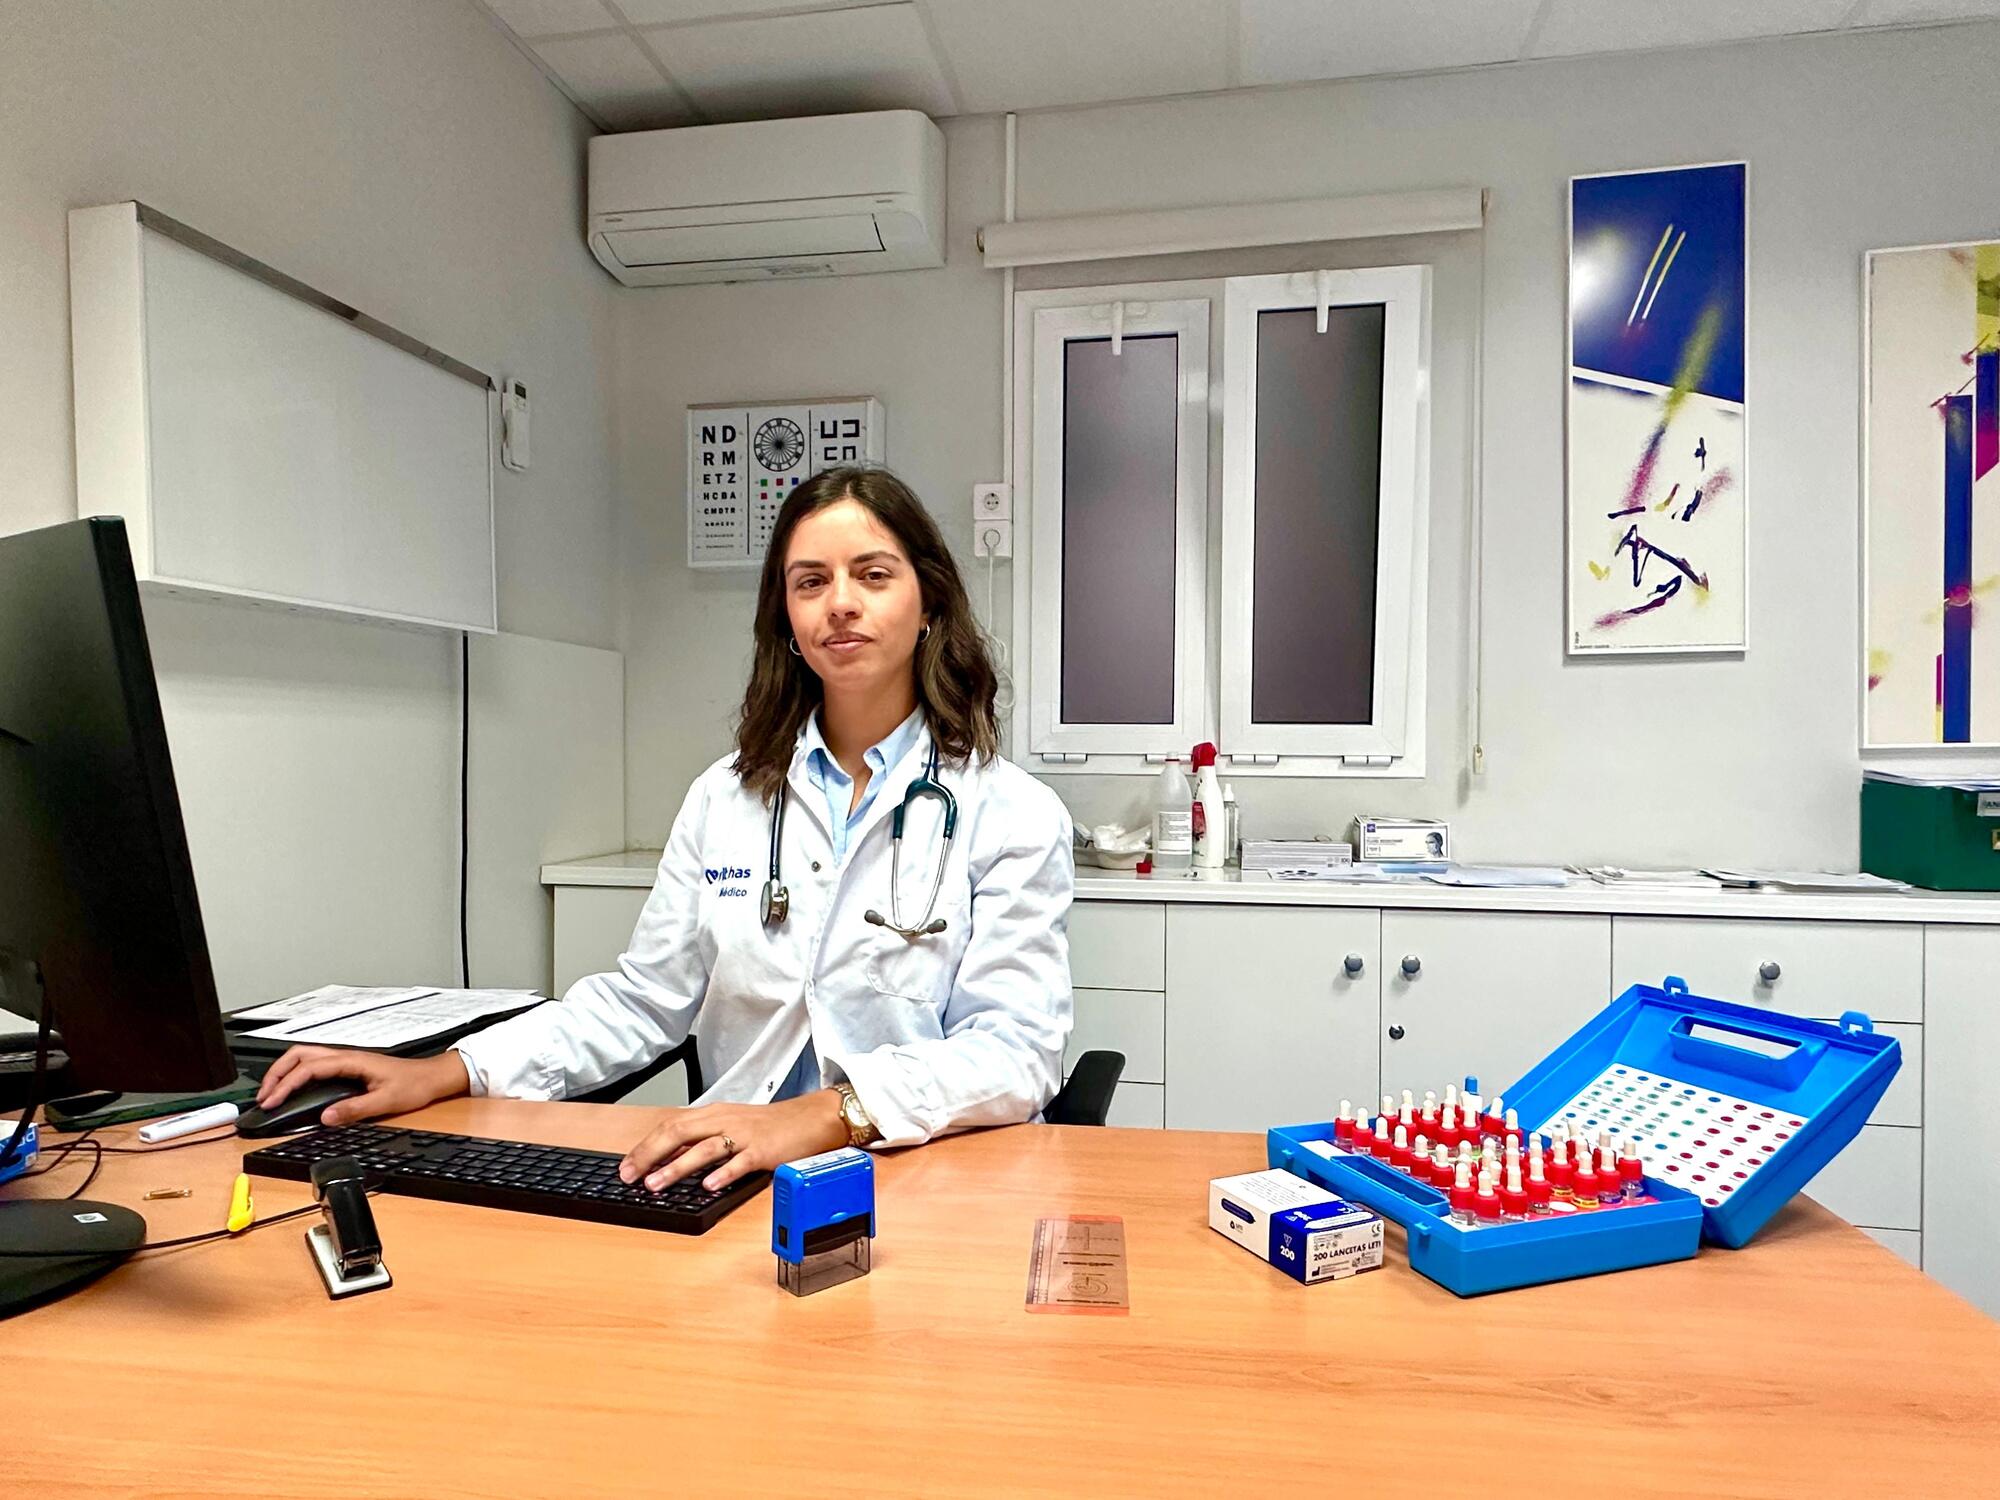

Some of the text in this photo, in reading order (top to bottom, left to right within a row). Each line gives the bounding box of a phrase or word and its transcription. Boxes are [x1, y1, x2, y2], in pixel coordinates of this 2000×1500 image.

[1280, 1245, 1295, 1261] 200
[1313, 1240, 1381, 1261] 200 LANCETAS LETI
